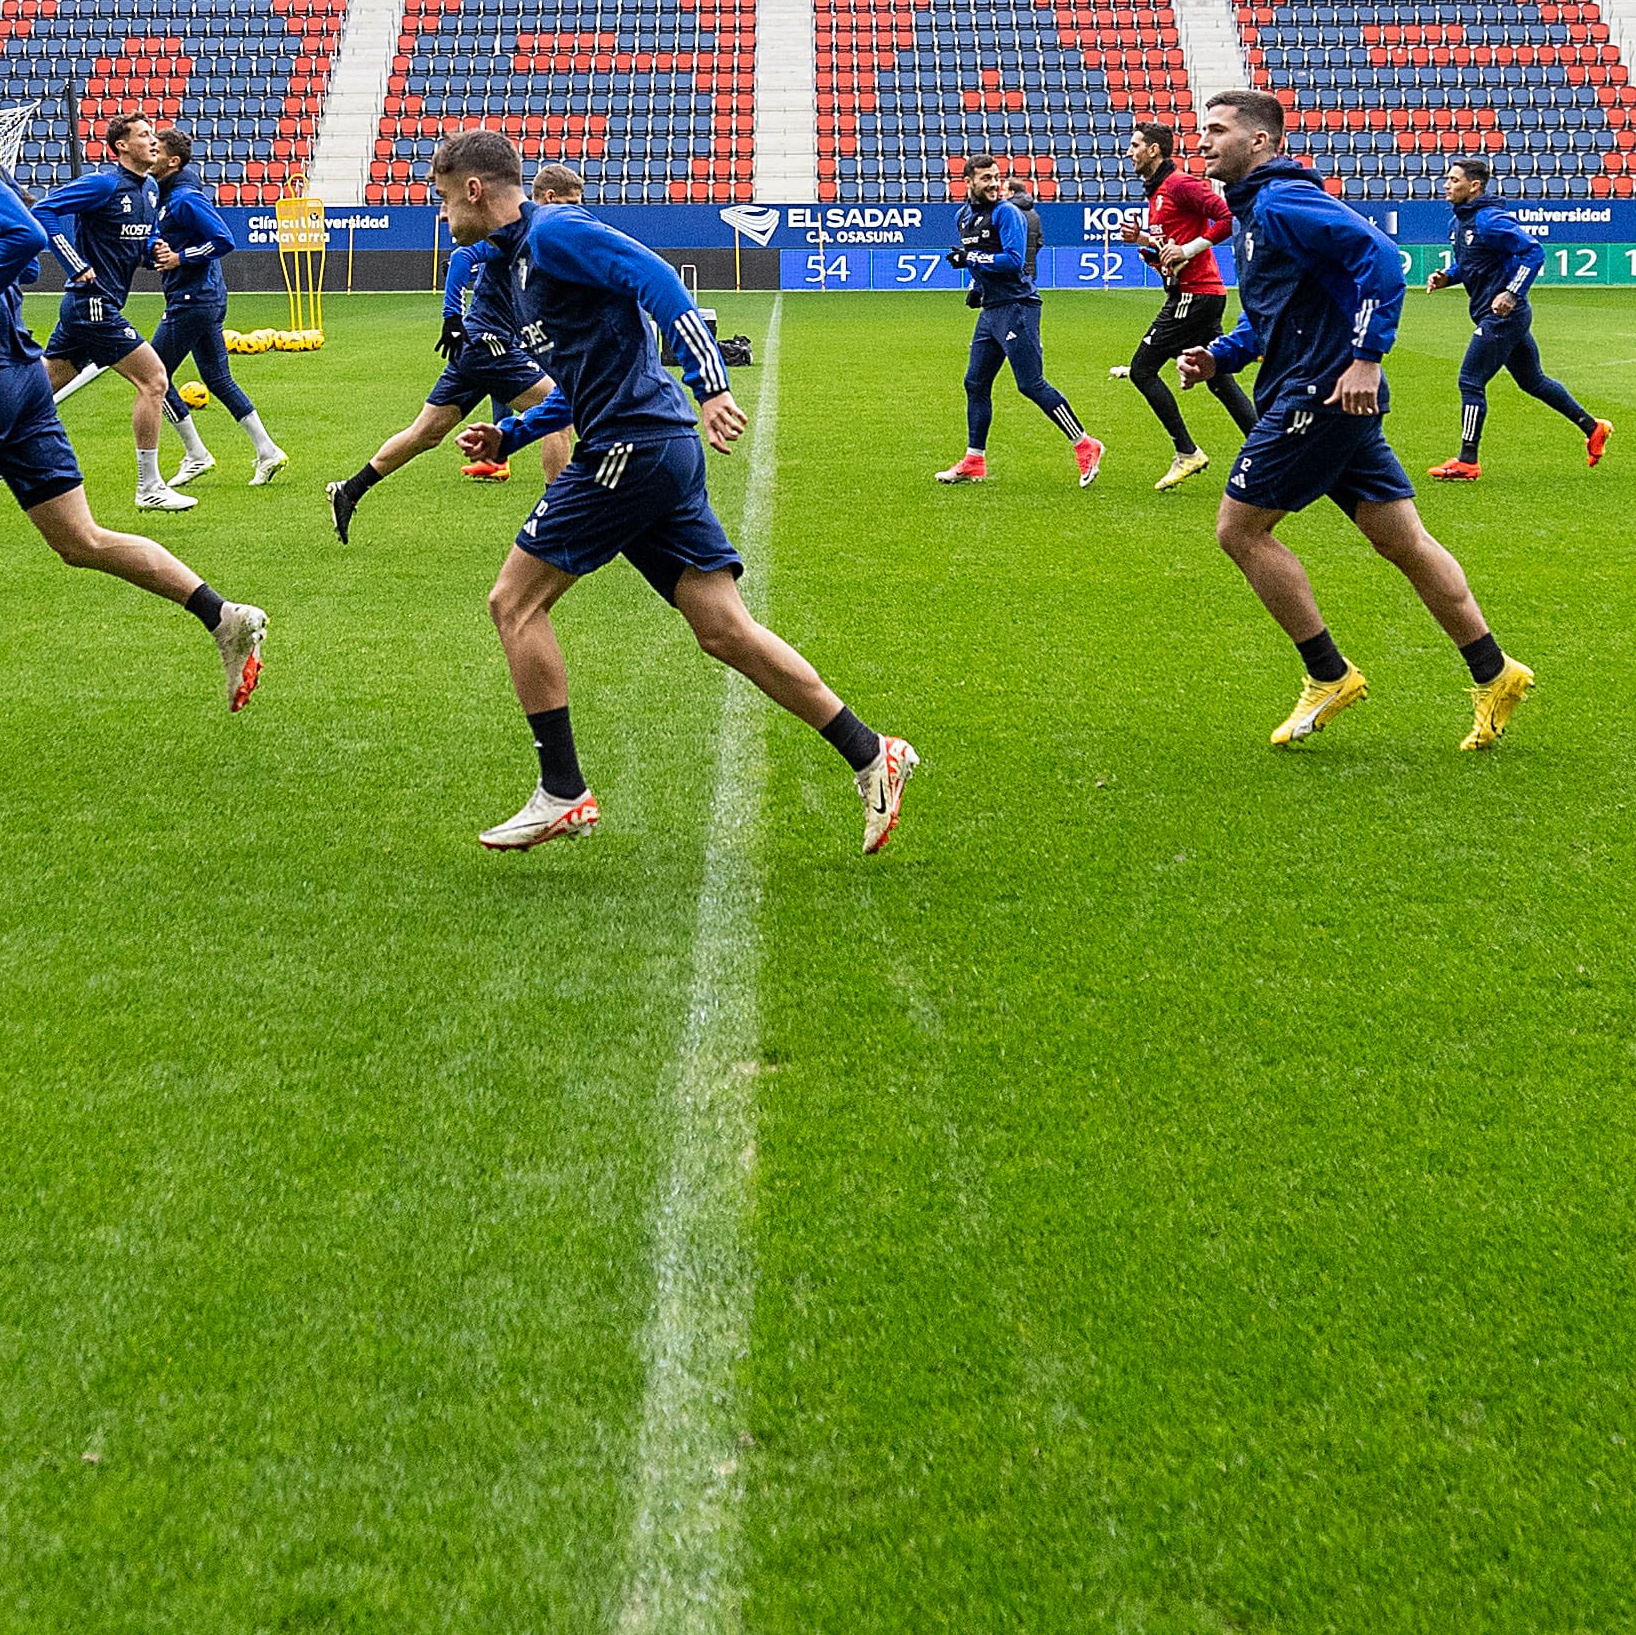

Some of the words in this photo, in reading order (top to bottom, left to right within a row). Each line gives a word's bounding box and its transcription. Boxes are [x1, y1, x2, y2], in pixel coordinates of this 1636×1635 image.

[787, 208, 821, 228] EL
[825, 207, 922, 228] SADAR
[1517, 207, 1612, 222] Universidad
[248, 230, 268, 244] de
[806, 231, 834, 244] C.A.
[837, 231, 905, 243] OSASUNA
[805, 254, 851, 283] 54
[896, 254, 942, 282] 57
[1078, 254, 1124, 281] 52
